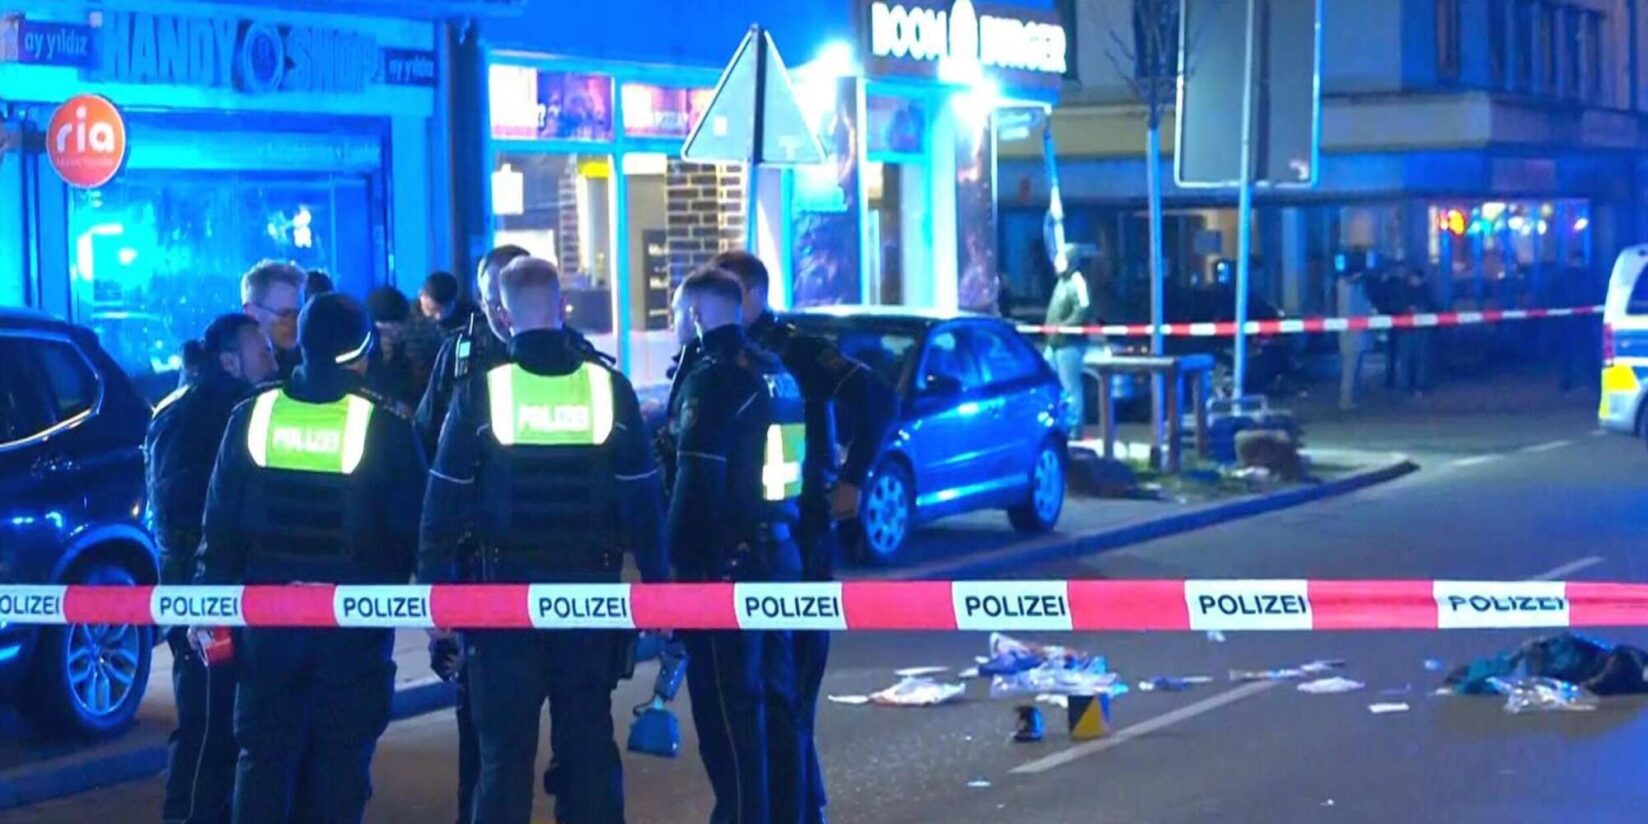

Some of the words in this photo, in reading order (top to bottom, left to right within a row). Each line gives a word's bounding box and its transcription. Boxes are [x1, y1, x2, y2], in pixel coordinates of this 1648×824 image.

[25, 32, 44, 60] ay
[103, 11, 239, 90] HANDY
[287, 26, 378, 93] SHOP
[871, 2, 947, 61] BOOM
[979, 14, 1066, 74] BURGER
[56, 105, 115, 154] ria
[519, 403, 590, 432] POLIZEI
[271, 426, 341, 454] POLIZEI
[159, 596, 239, 617] POLIZEI
[343, 597, 427, 618] POLIZEI
[538, 597, 628, 618] POLIZEI
[744, 596, 840, 618] POLIZEI
[965, 595, 1066, 617] POLIZEI
[1198, 594, 1307, 615] POLIZEI
[1447, 595, 1564, 612] POLIZEI
